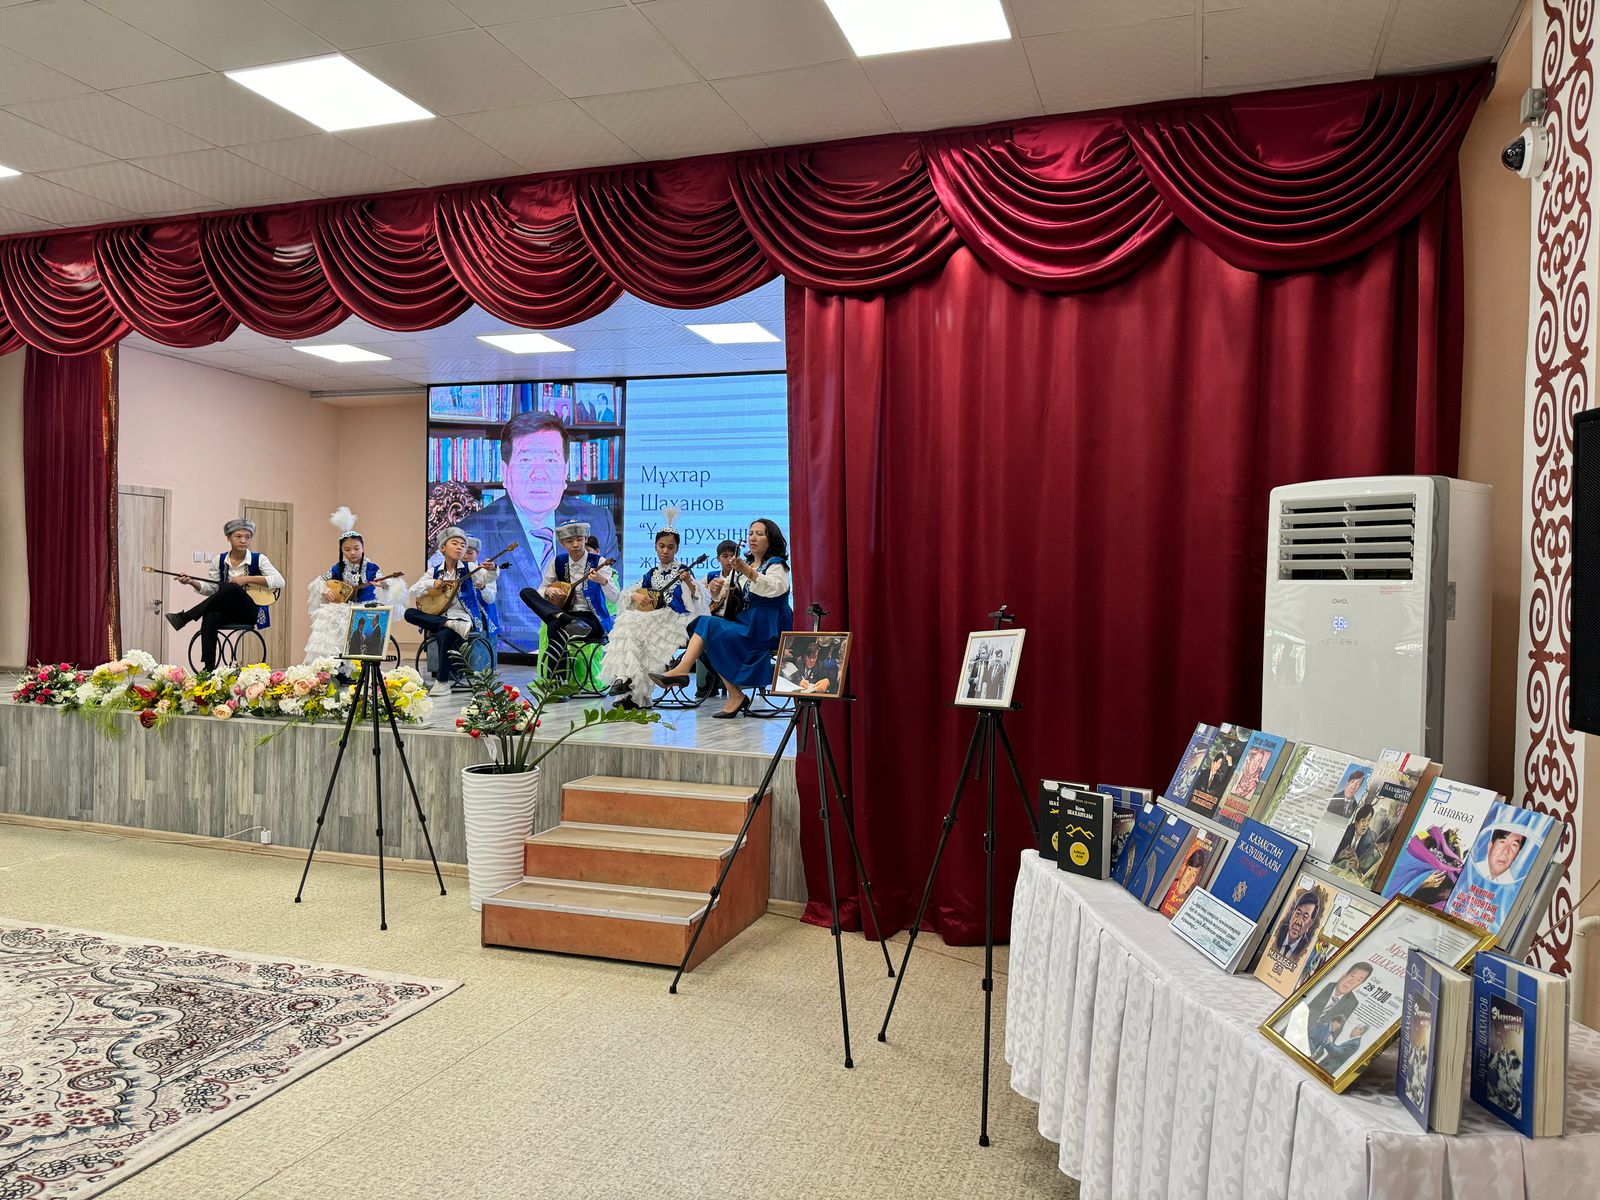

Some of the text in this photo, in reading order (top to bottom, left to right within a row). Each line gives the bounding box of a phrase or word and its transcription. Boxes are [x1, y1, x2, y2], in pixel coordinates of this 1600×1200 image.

[641, 465, 711, 488] Мұхтар
[641, 494, 724, 511] Шаханов
[684, 528, 749, 545] рухын
[1432, 801, 1475, 824] Танакөз
[1237, 840, 1281, 873] ЖАЗУШЫЛАРЫ
[1368, 953, 1405, 978] ШАХАНО
[1363, 982, 1375, 992] 28
[1371, 987, 1392, 1003] 11:00
[1479, 997, 1489, 1045] ШАХАНОВ
